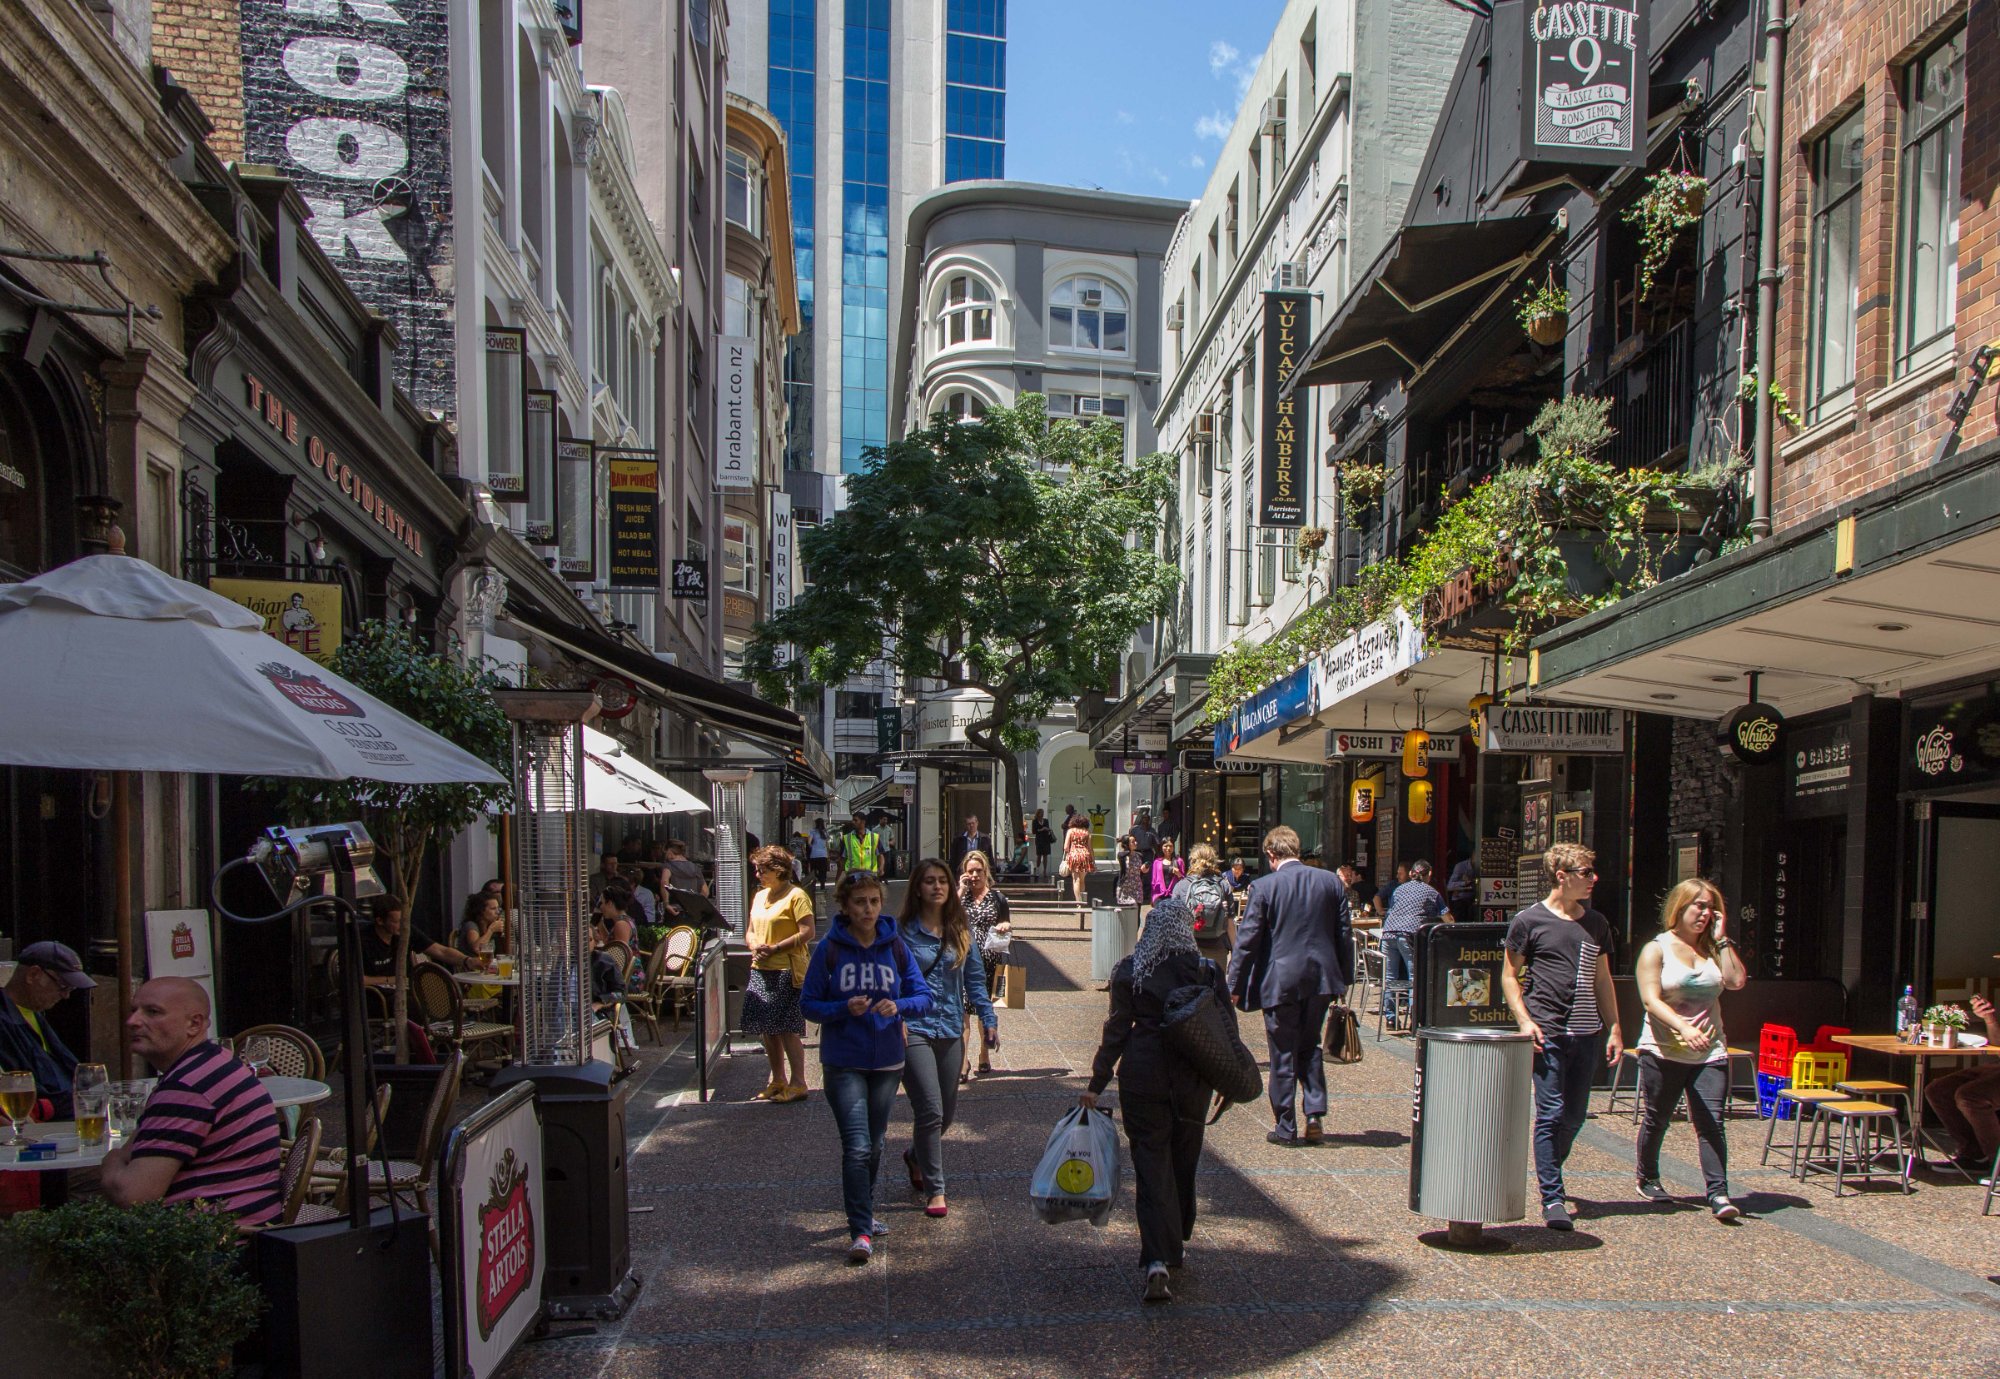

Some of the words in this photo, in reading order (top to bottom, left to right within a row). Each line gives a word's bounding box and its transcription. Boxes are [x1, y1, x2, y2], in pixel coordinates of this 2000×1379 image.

[1530, 2, 1639, 50] CASSETTE
[1568, 36, 1602, 86] 9
[1555, 92, 1592, 106] LAISSEZ
[1597, 86, 1614, 98] LES
[1561, 112, 1584, 125] BONS
[1587, 105, 1614, 120] TEMPS
[1575, 123, 1607, 141] ROULER
[1231, 232, 1278, 340] BUILDING
[1278, 301, 1297, 382] VULCAN
[725, 346, 742, 471] brabant.co.nz
[561, 447, 589, 458] POWER!
[1275, 393, 1297, 497] HAMBERS
[248, 373, 298, 447] THE
[309, 435, 423, 558] OCCIDENTAL
[719, 472, 749, 482] barristers
[616, 504, 635, 513] FRESH
[636, 504, 652, 513] MADE
[1268, 505, 1301, 513] Barristers
[1272, 512, 1281, 520] At
[1282, 512, 1297, 521] Law
[624, 515, 645, 524] JUICES
[618, 532, 638, 540] SALAD
[639, 532, 652, 540] BAR
[632, 550, 652, 558] MEALS
[561, 560, 589, 571] POWER!
[612, 566, 638, 575] HEALTHY
[639, 566, 659, 576] STYLE
[1323, 651, 1355, 686] JAPANESE
[1357, 620, 1404, 663] RESTAURT
[1336, 678, 1349, 694] SUSHI
[1355, 665, 1370, 681] SAKE
[1370, 656, 1384, 675] BAR
[280, 682, 331, 698] STELLA
[296, 696, 348, 710] ARTOIS
[324, 719, 383, 739] GOLD
[1239, 707, 1264, 733] VULCAN
[1501, 710, 1573, 734] CASSETTE
[1577, 709, 1614, 735] NINE
[1738, 717, 1778, 749] White's
[345, 738, 398, 751] STANDARD
[1338, 735, 1383, 752] SUSHI
[1390, 736, 1456, 753] FAORY
[1525, 801, 1536, 823] $1
[1484, 908, 1503, 922] $1
[176, 944, 191, 952] ARTOIS
[840, 963, 895, 992] GAP
[1469, 1008, 1505, 1022] Sushi
[1412, 1067, 1422, 1122] Litter
[487, 1201, 525, 1264] STELLA
[488, 1235, 526, 1304] ARTOIS
